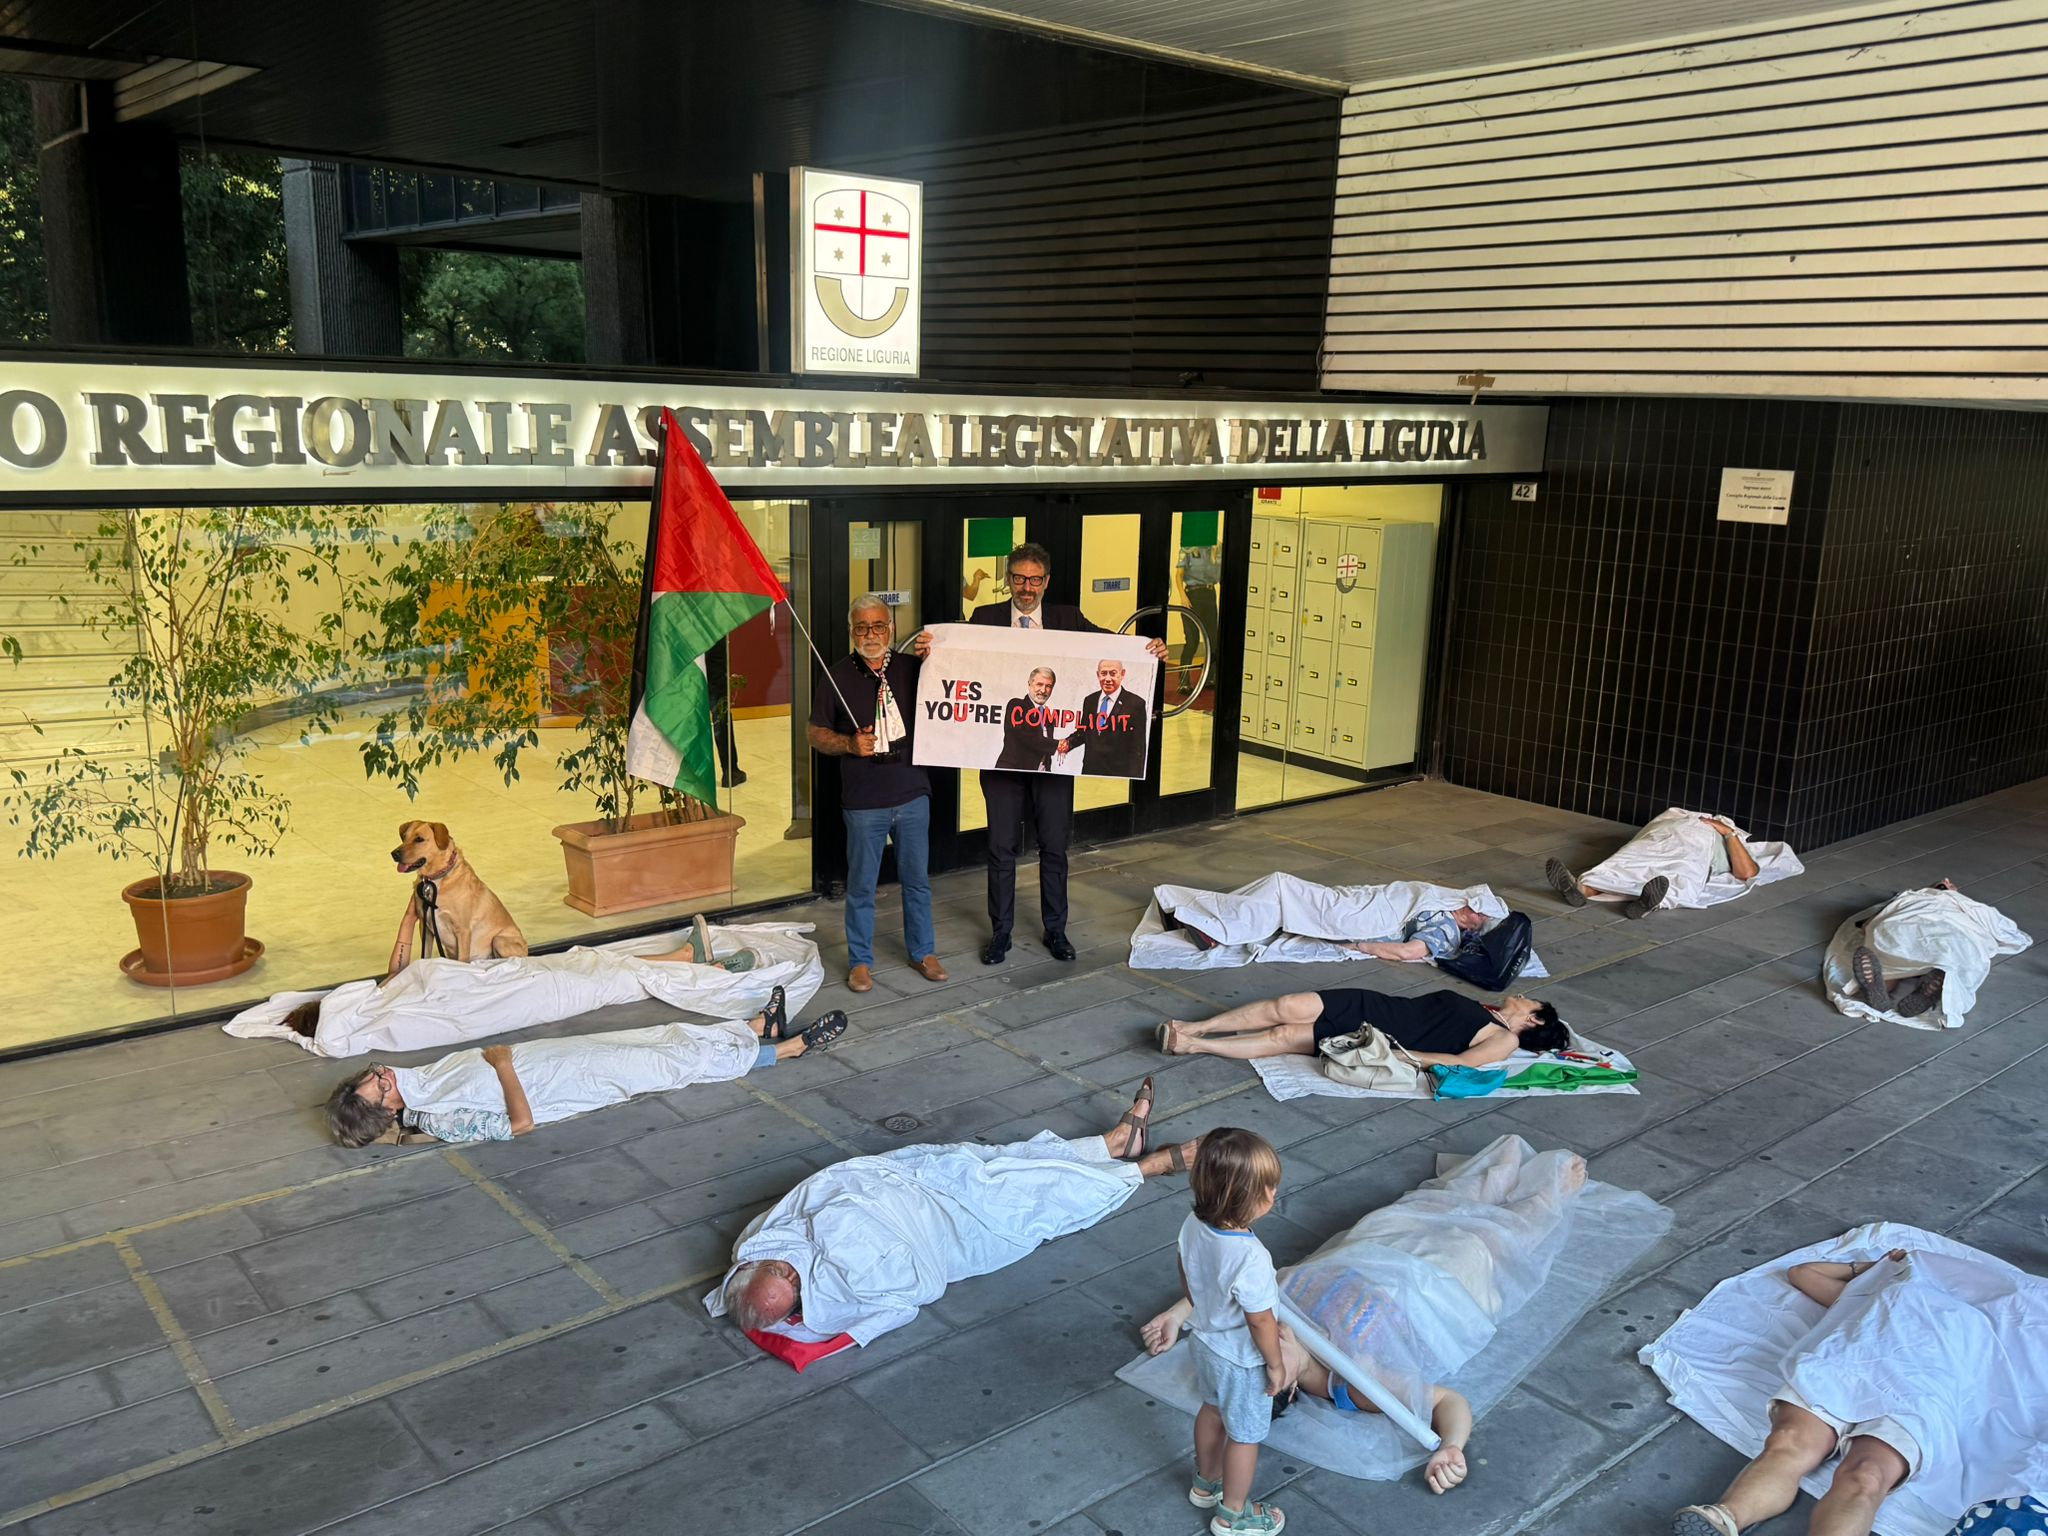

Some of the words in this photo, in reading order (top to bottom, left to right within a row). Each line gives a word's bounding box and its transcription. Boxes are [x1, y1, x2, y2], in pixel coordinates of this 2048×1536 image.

[811, 346, 863, 363] REGIONE
[866, 348, 911, 365] LIGURIA
[0, 389, 68, 469] O
[81, 391, 575, 468] REGIONALE
[936, 413, 1225, 468] LEGISLATIVA
[1226, 418, 1351, 464] DELLA
[1351, 418, 1488, 462] LIGURIA
[1515, 485, 1530, 498] 42
[941, 679, 982, 701] YES
[924, 700, 1002, 724] YOU'RE
[1010, 704, 1134, 733] COMPLICIT.
